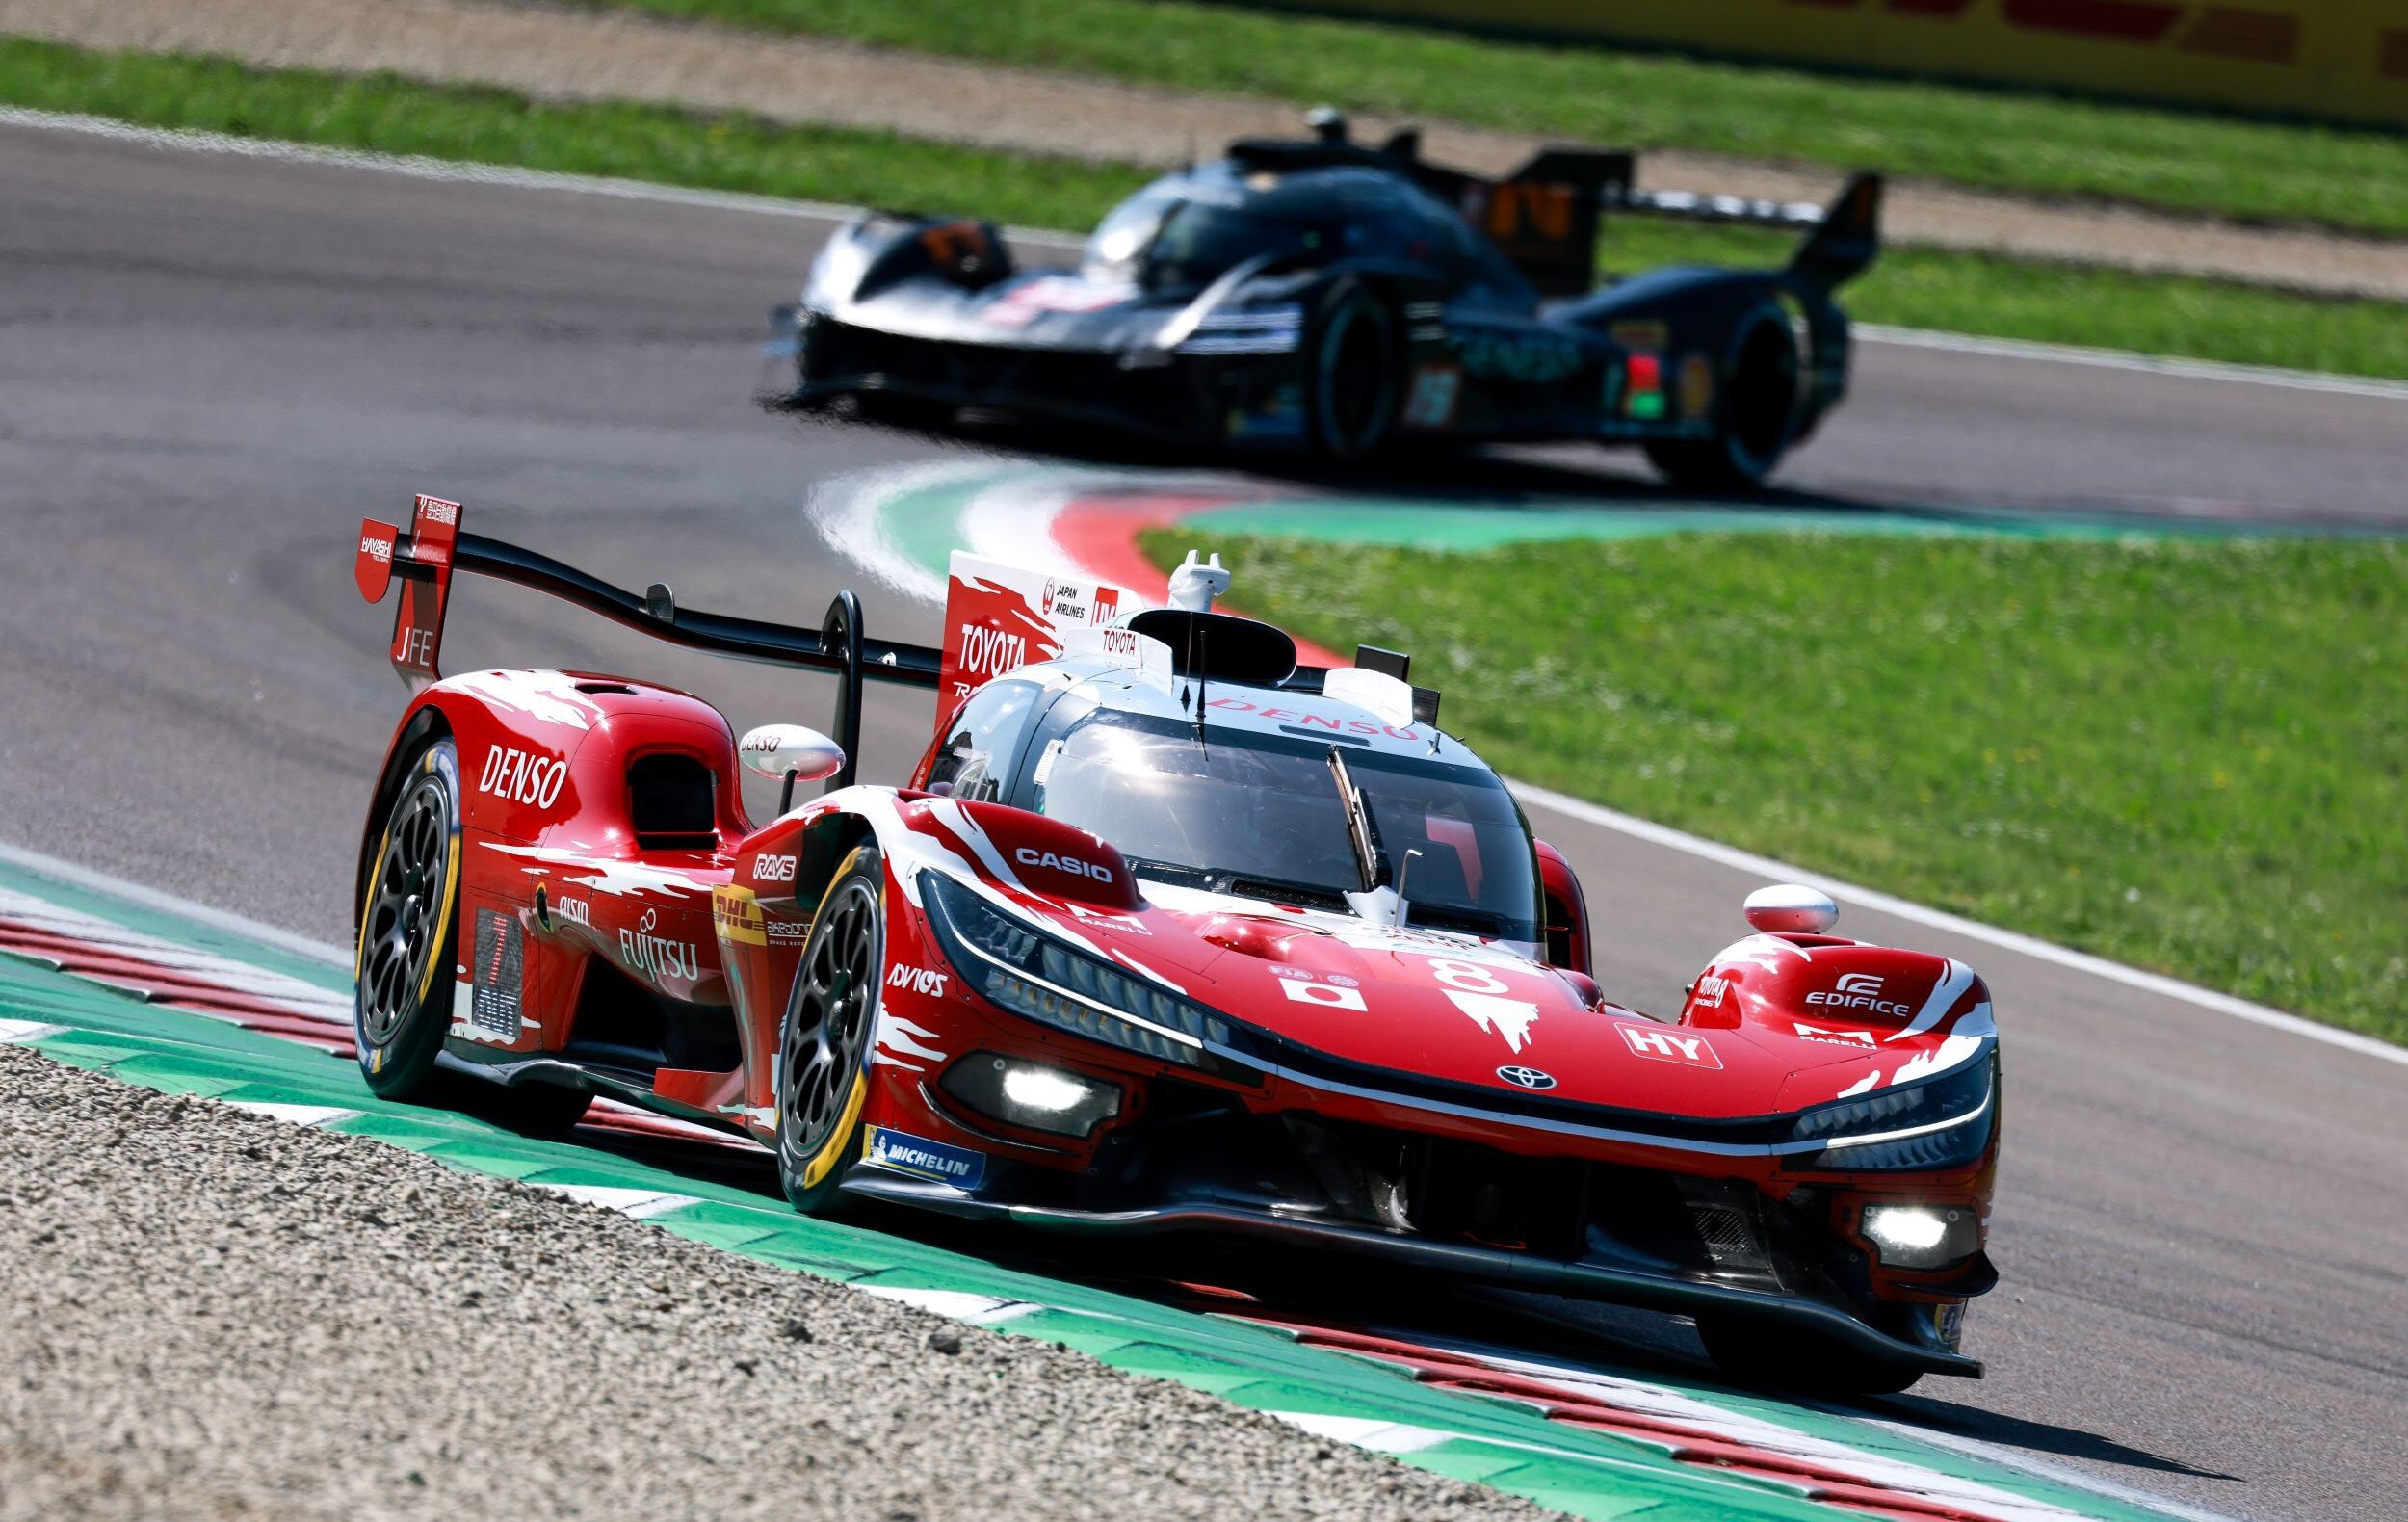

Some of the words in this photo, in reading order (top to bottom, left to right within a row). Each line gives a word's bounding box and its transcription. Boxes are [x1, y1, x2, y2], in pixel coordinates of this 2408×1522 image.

[361, 537, 392, 557] HAYASHI
[1057, 585, 1078, 599] JAPAN
[1055, 602, 1086, 618] AIRLINES
[396, 627, 433, 667] JFE
[959, 624, 1026, 678] TOYOTA
[1103, 631, 1136, 655] TOYOTA
[1205, 698, 1419, 741] DENSO
[742, 735, 781, 752] DENSO
[479, 744, 567, 810] DENSO
[753, 853, 797, 881] RAYS
[1016, 848, 1113, 883] CASIO
[560, 896, 589, 926] AISIN
[716, 895, 753, 930] DHL
[1078, 917, 1153, 936] MARELLI
[767, 921, 812, 934] akebon
[619, 927, 698, 982] FUJITSU
[886, 963, 948, 998] ADVICS
[1427, 958, 1509, 994] 8
[1805, 992, 1910, 1017] EDIFICE
[1624, 1028, 1700, 1061] HY
[1799, 1035, 1877, 1051] MARELLI
[887, 1144, 970, 1176] MICHELIN
